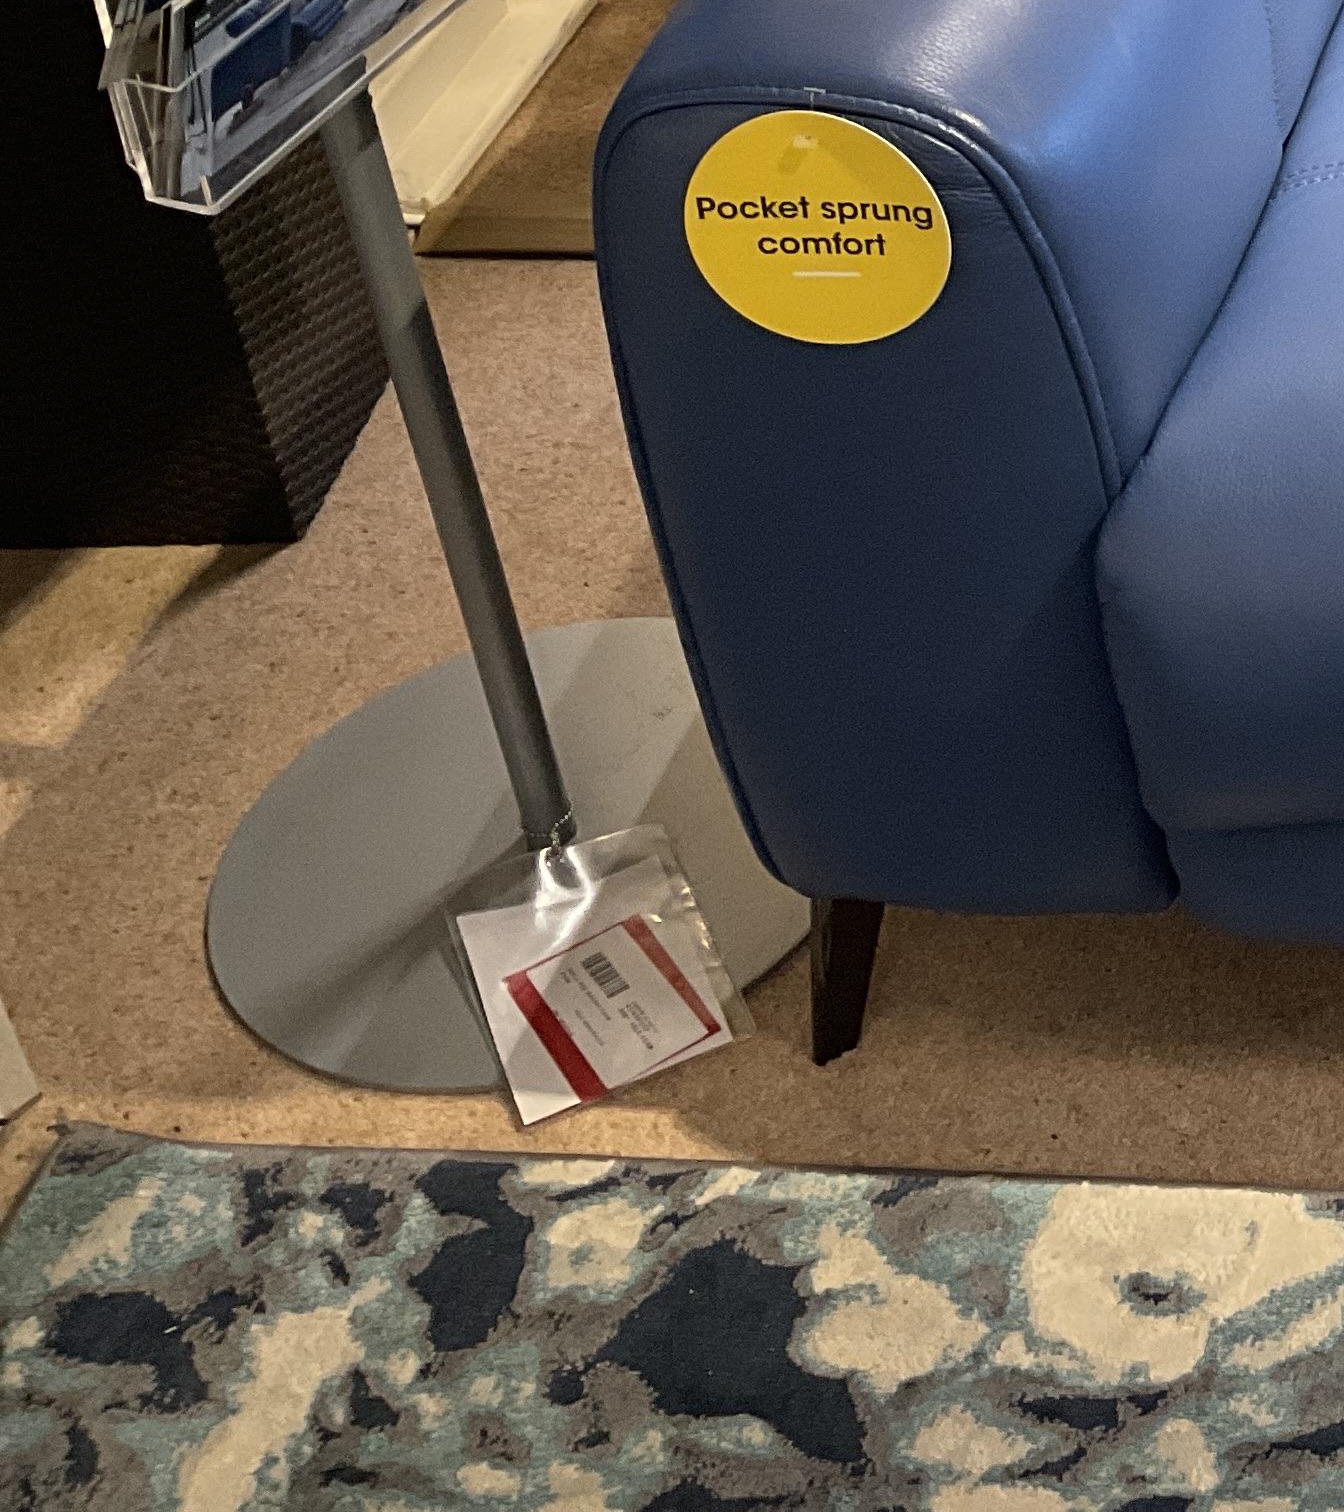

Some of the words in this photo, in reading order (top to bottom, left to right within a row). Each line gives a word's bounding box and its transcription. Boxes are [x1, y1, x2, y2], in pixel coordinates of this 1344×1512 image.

[695, 196, 810, 220] Pocket
[820, 201, 934, 230] sprung
[757, 232, 887, 256] comfort
